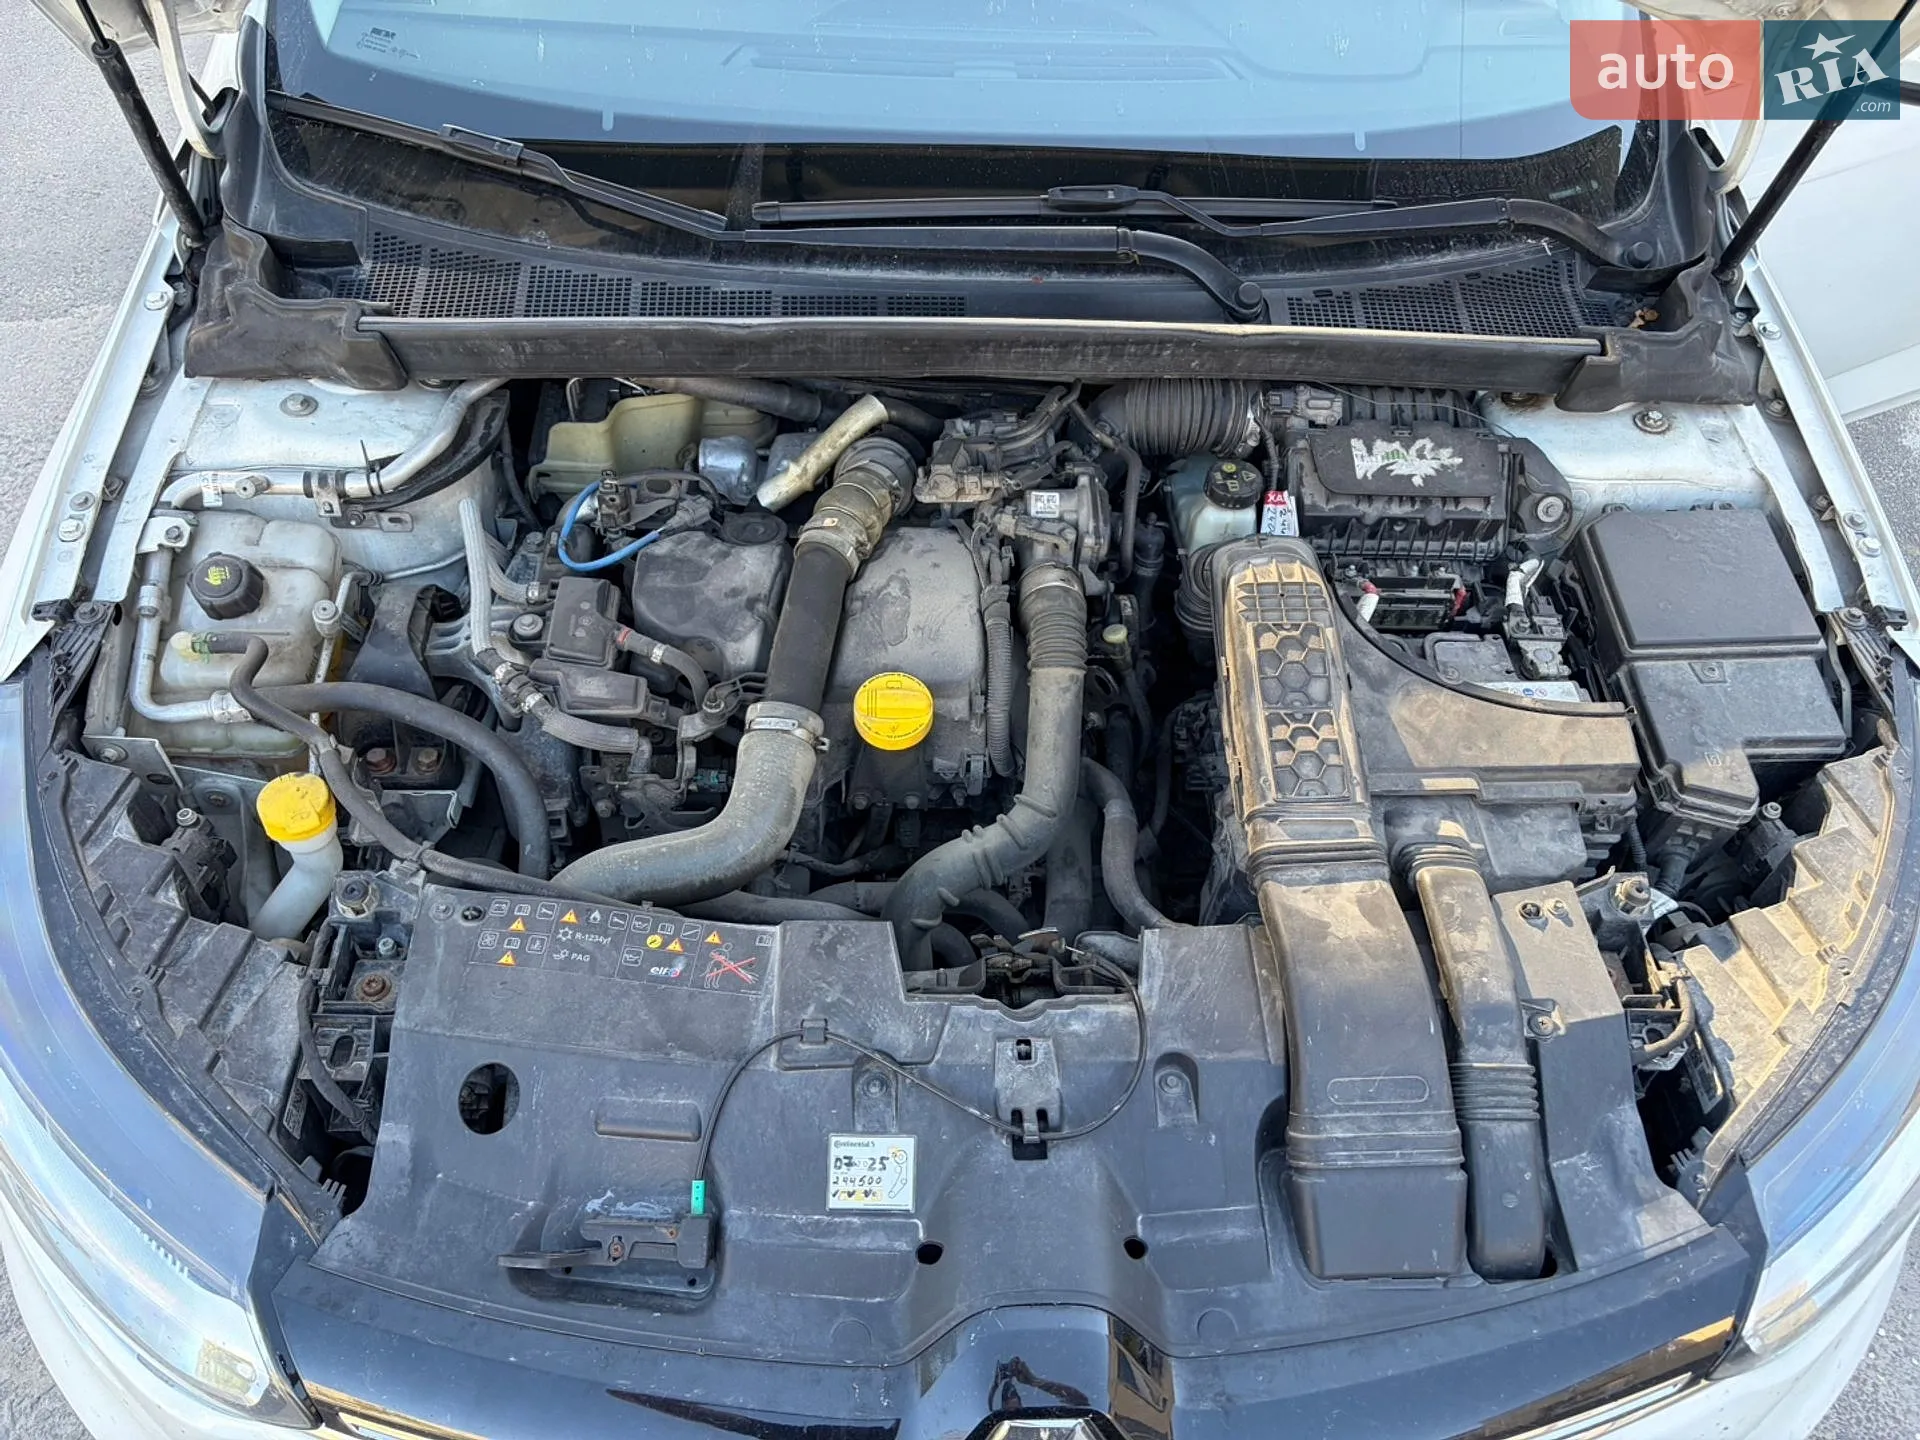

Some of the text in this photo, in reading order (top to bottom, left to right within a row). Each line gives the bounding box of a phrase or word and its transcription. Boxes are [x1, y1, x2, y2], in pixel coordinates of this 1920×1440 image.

[575, 932, 611, 945] R-1234yf
[571, 953, 591, 962] PAG
[833, 1140, 870, 1148] Continental
